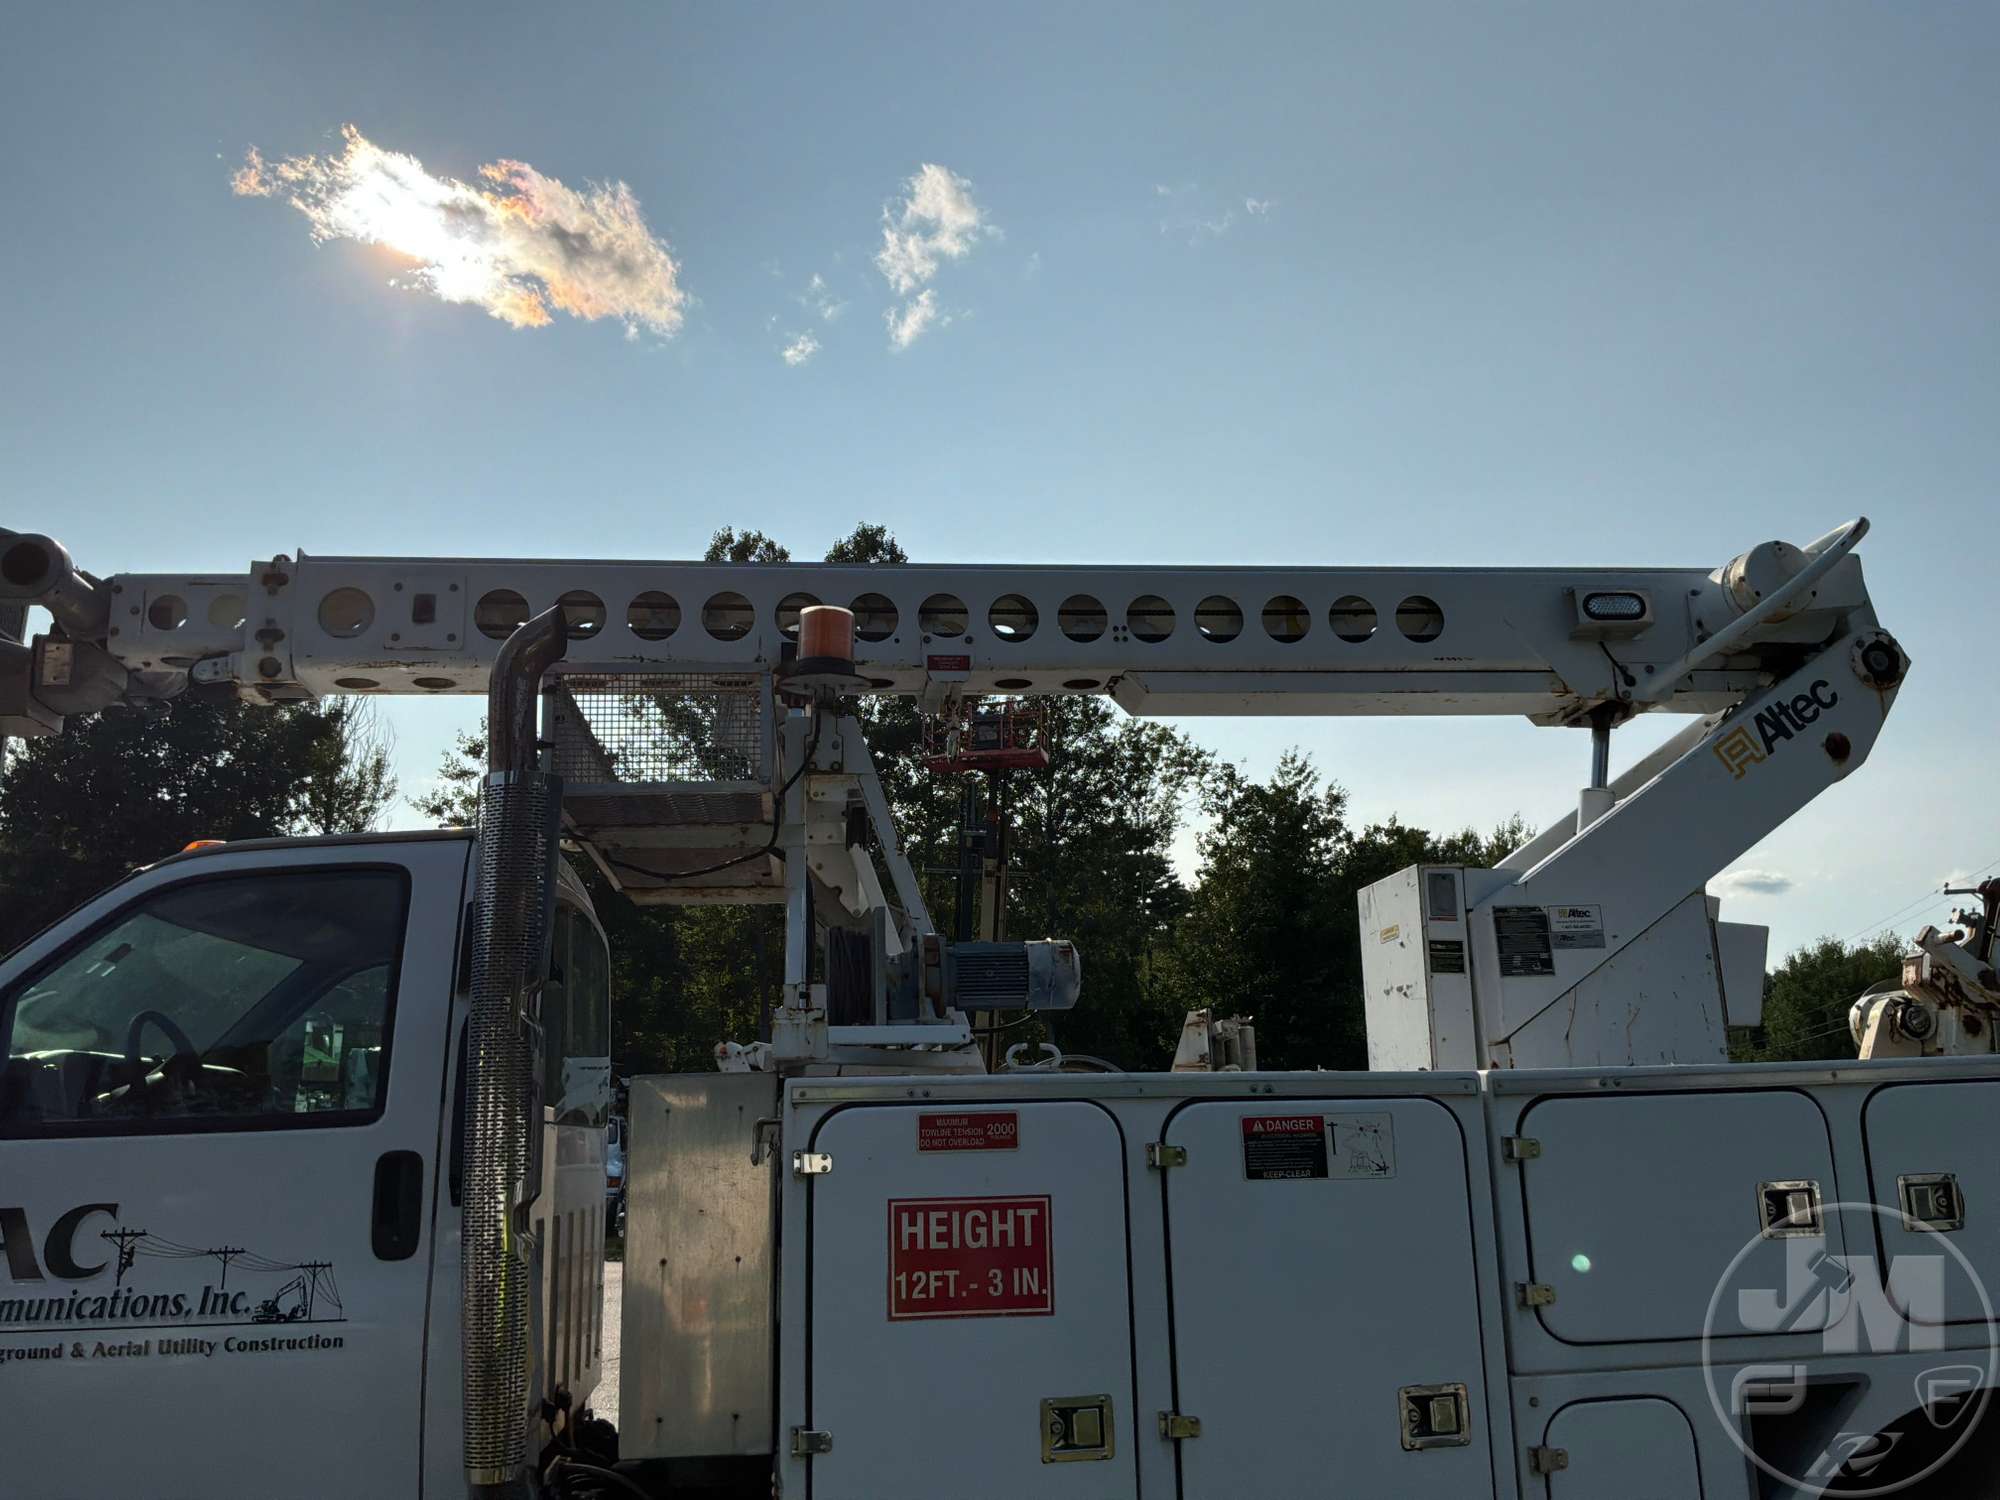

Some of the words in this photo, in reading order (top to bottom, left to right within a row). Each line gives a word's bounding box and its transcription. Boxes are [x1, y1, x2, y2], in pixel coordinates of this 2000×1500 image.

[1754, 679, 1838, 755] Altec
[936, 1118, 969, 1126] MAXIMUM
[1266, 1119, 1315, 1132] DANGER
[920, 1128, 952, 1137] TOWLINE
[953, 1127, 984, 1136] TENSION
[986, 1122, 1016, 1136] 2000
[920, 1138, 931, 1147] DO
[932, 1138, 946, 1146] NOT
[948, 1137, 985, 1146] OVERLOAD
[1286, 1169, 1311, 1177] CLEAR
[901, 1208, 1039, 1250] HEIGHT
[988, 1269, 1004, 1296] 3
[1013, 1267, 1048, 1297] IN.
[70, 1342, 85, 1358] &
[92, 1340, 150, 1358] Aerial
[158, 1337, 217, 1357] Utility
[224, 1334, 344, 1353] Construction
